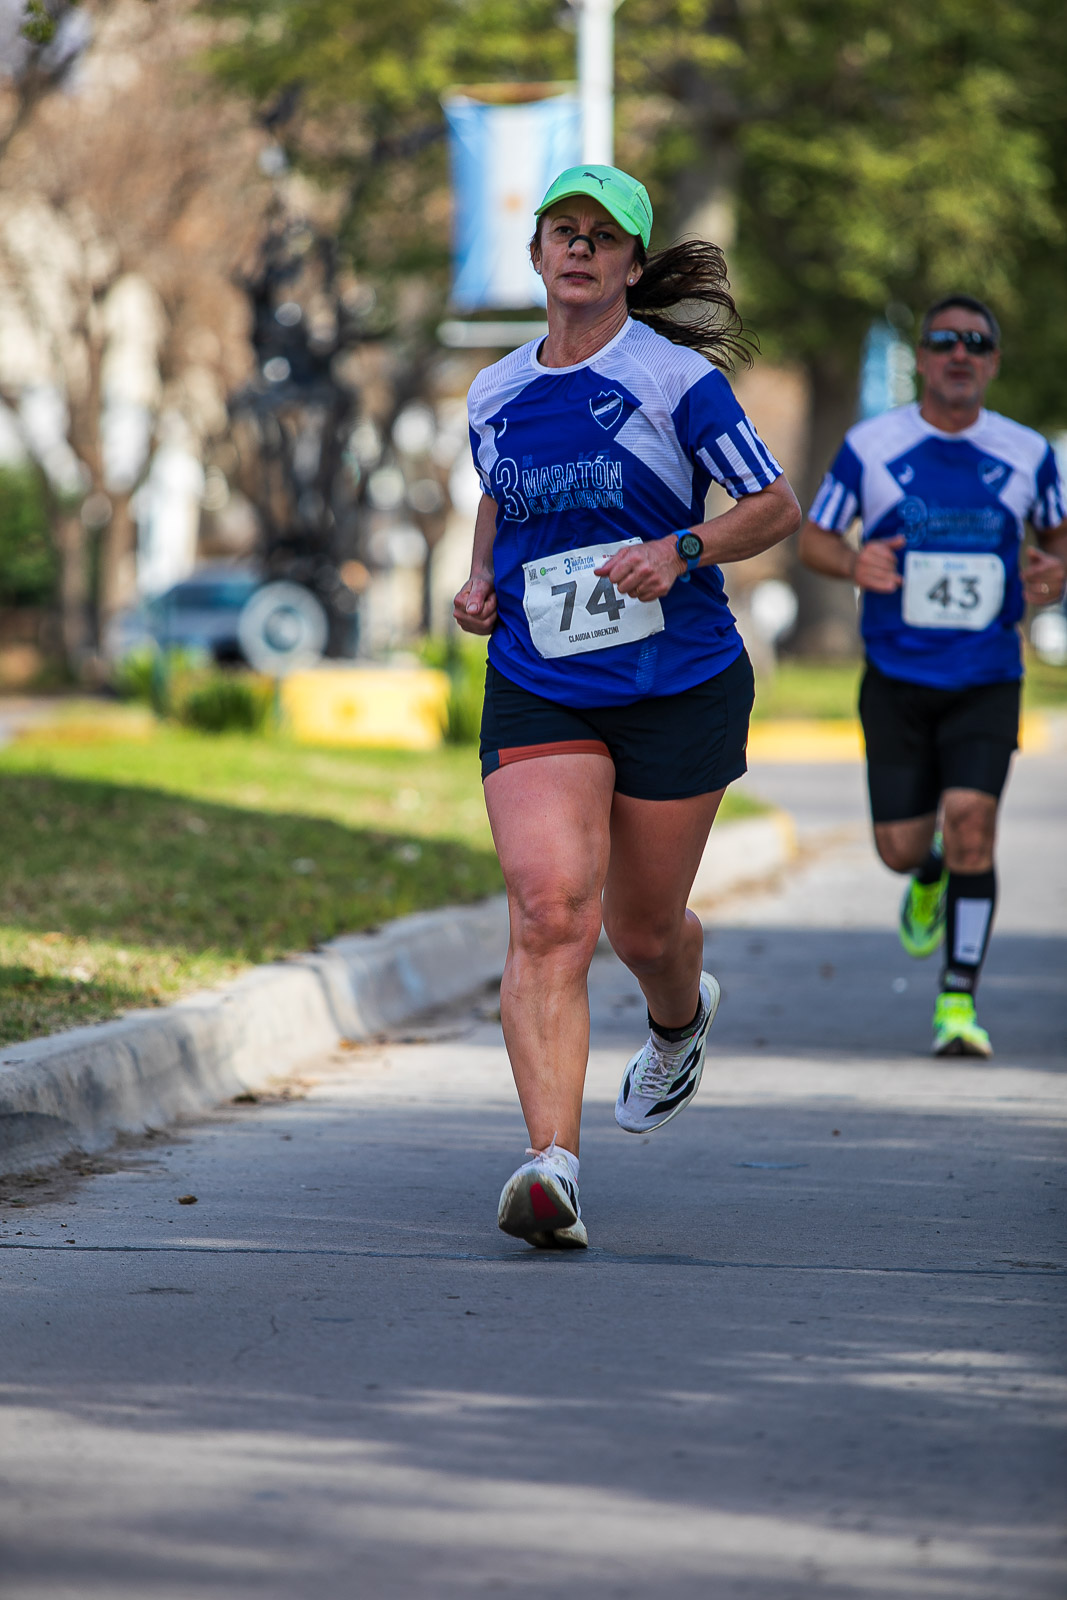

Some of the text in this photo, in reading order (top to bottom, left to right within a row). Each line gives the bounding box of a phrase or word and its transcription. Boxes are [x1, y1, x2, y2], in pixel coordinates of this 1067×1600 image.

[495, 455, 623, 522] 3 MARATÓN
[563, 558, 572, 575] 3
[551, 575, 625, 632] 74
[927, 574, 980, 609] 43
[568, 626, 619, 643] CLAUDIA LORENZINI
